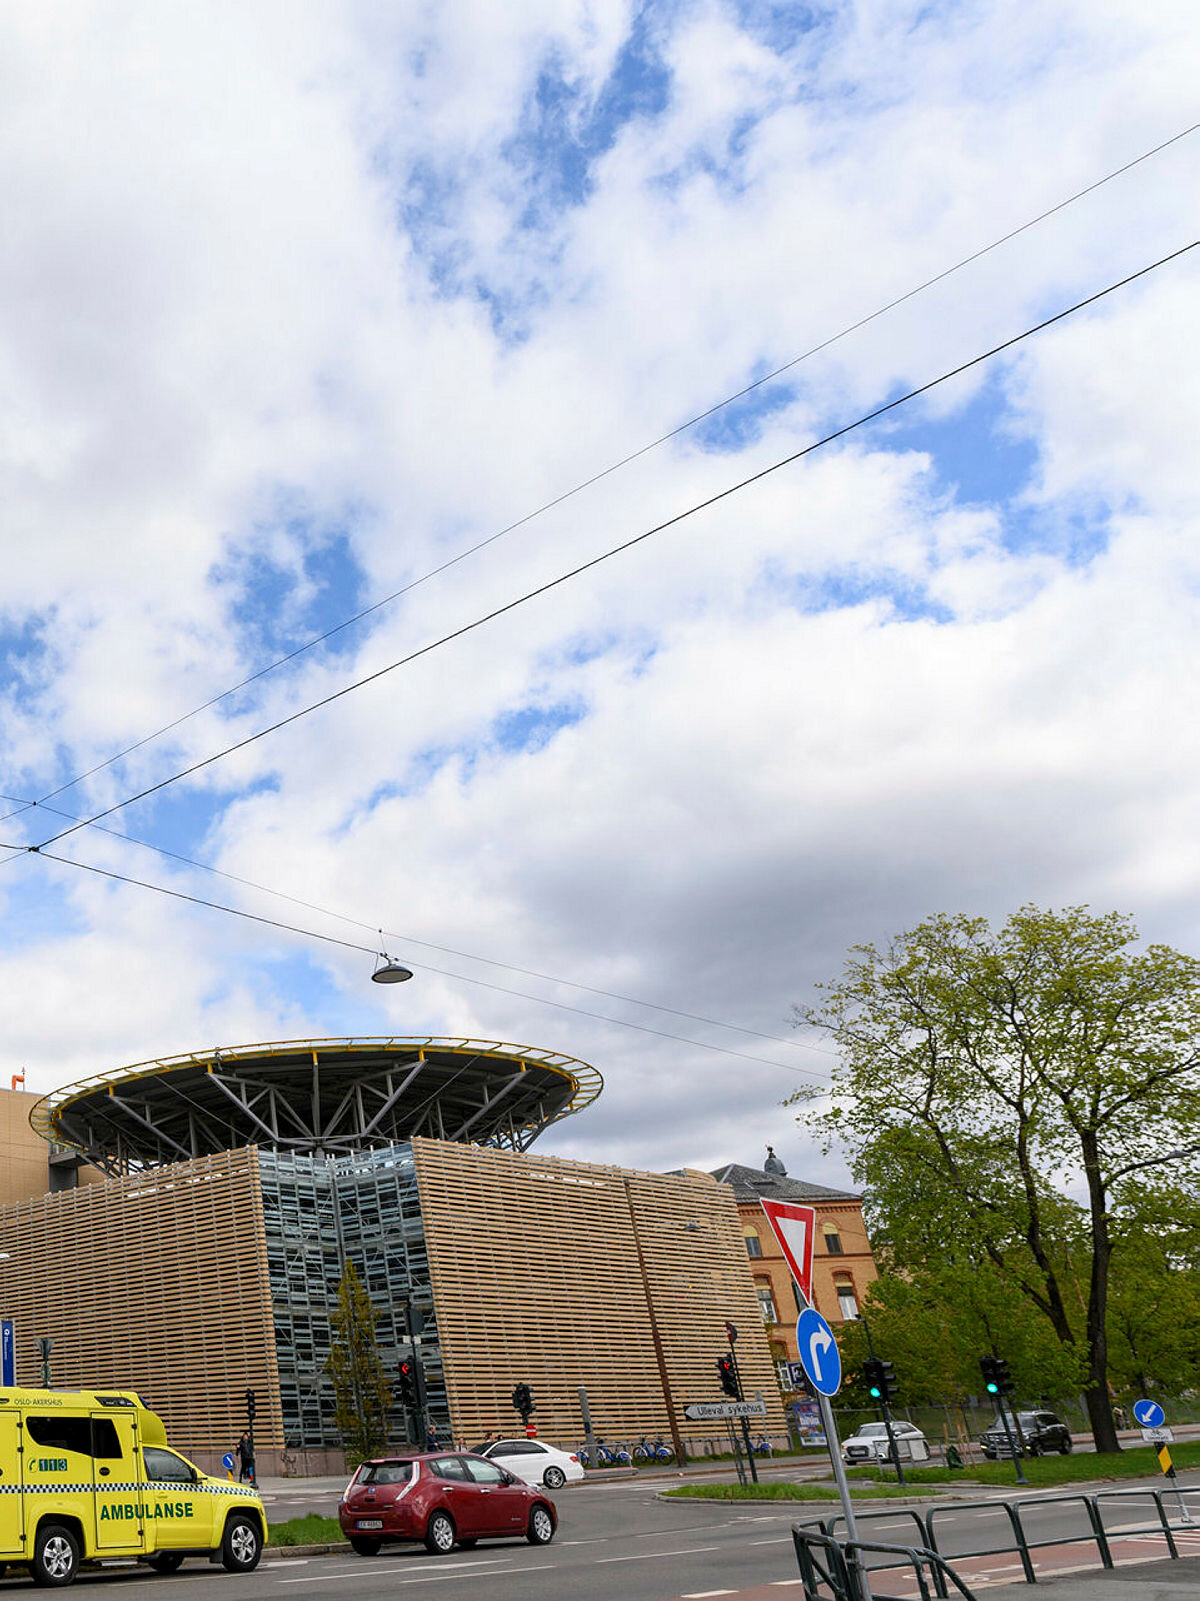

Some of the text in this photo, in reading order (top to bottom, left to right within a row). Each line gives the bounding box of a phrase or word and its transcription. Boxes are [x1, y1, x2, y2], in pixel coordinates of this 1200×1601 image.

[727, 1404, 763, 1415] sykehus
[40, 1459, 67, 1471] 113
[100, 1502, 194, 1520] AMBULANSE
